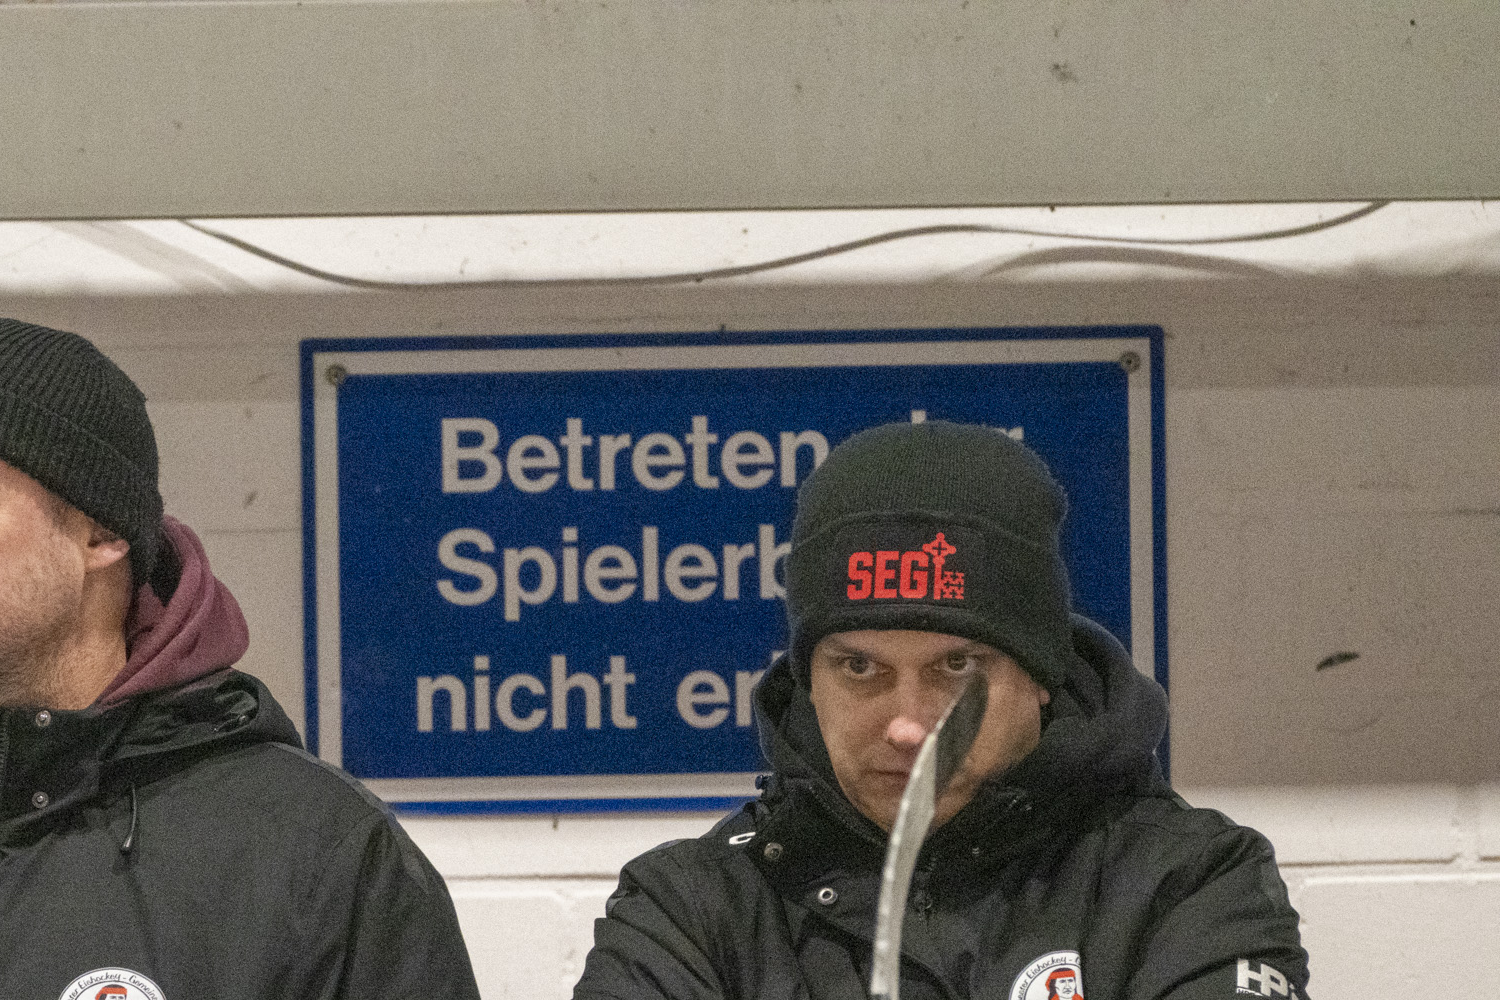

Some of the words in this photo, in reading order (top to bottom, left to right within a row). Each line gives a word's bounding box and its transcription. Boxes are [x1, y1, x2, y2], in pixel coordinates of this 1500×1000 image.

[440, 414, 829, 494] Betreten
[436, 524, 793, 620] Spielerb
[416, 654, 637, 733] nicht
[676, 651, 784, 727] er
[78, 972, 121, 990] Eishockey
